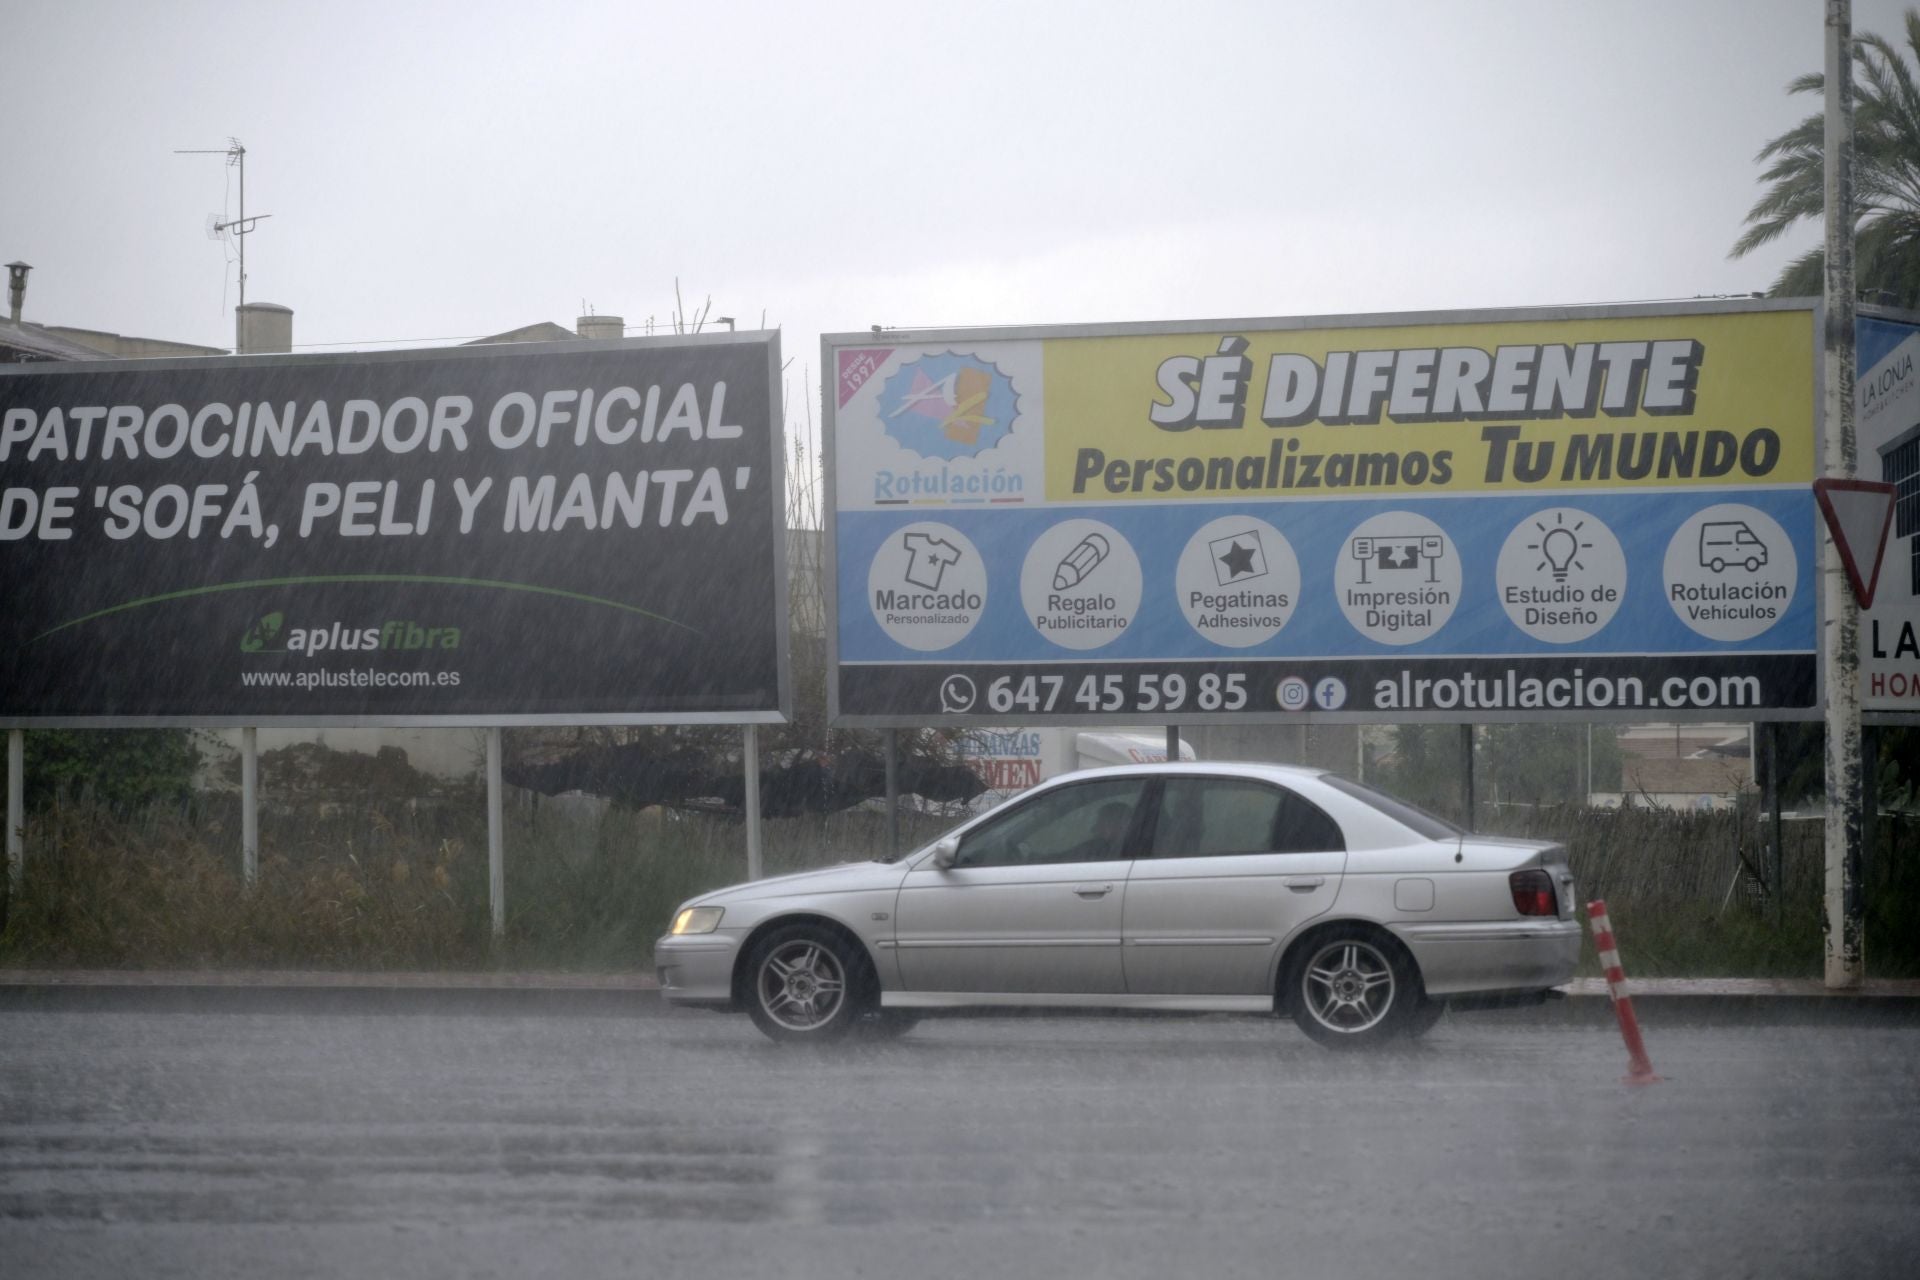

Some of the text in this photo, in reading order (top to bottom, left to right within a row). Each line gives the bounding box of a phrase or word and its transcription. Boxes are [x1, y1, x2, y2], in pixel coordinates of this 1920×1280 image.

[841, 352, 867, 379] DESDE
[847, 356, 876, 391] 1997
[1148, 335, 1705, 432] SÉ DIFERENTE
[1863, 353, 1913, 408] LA LONJA
[0, 380, 744, 462] PATROCINADOR OFICIAL
[1072, 438, 1453, 494] Personalizamos
[1560, 427, 1781, 482] MUNDO
[874, 466, 1023, 498] Rotulación
[0, 466, 751, 549] DE 'SOFÁ, PELI Y MANTA'
[876, 590, 981, 611] Marcado
[1189, 591, 1290, 614] Pegatinas
[1346, 587, 1451, 611] Impresión
[1504, 584, 1617, 604] Estudio de
[1670, 581, 1788, 601] Rotulación
[1047, 594, 1116, 617] Regalo
[1524, 605, 1599, 625] Diseño
[1687, 603, 1777, 620] Vehículos
[885, 614, 970, 625] Personalizado
[1036, 615, 1128, 631] Publicitario
[1196, 613, 1281, 629] Adhesivos
[1364, 609, 1433, 632] Digital
[286, 621, 462, 657] aplusfibra
[1872, 619, 1920, 660] LA
[241, 667, 461, 691] www.aplustelecom.es
[1373, 668, 1762, 709] alrotulacion.com
[988, 673, 1248, 713] 647 45 59 85
